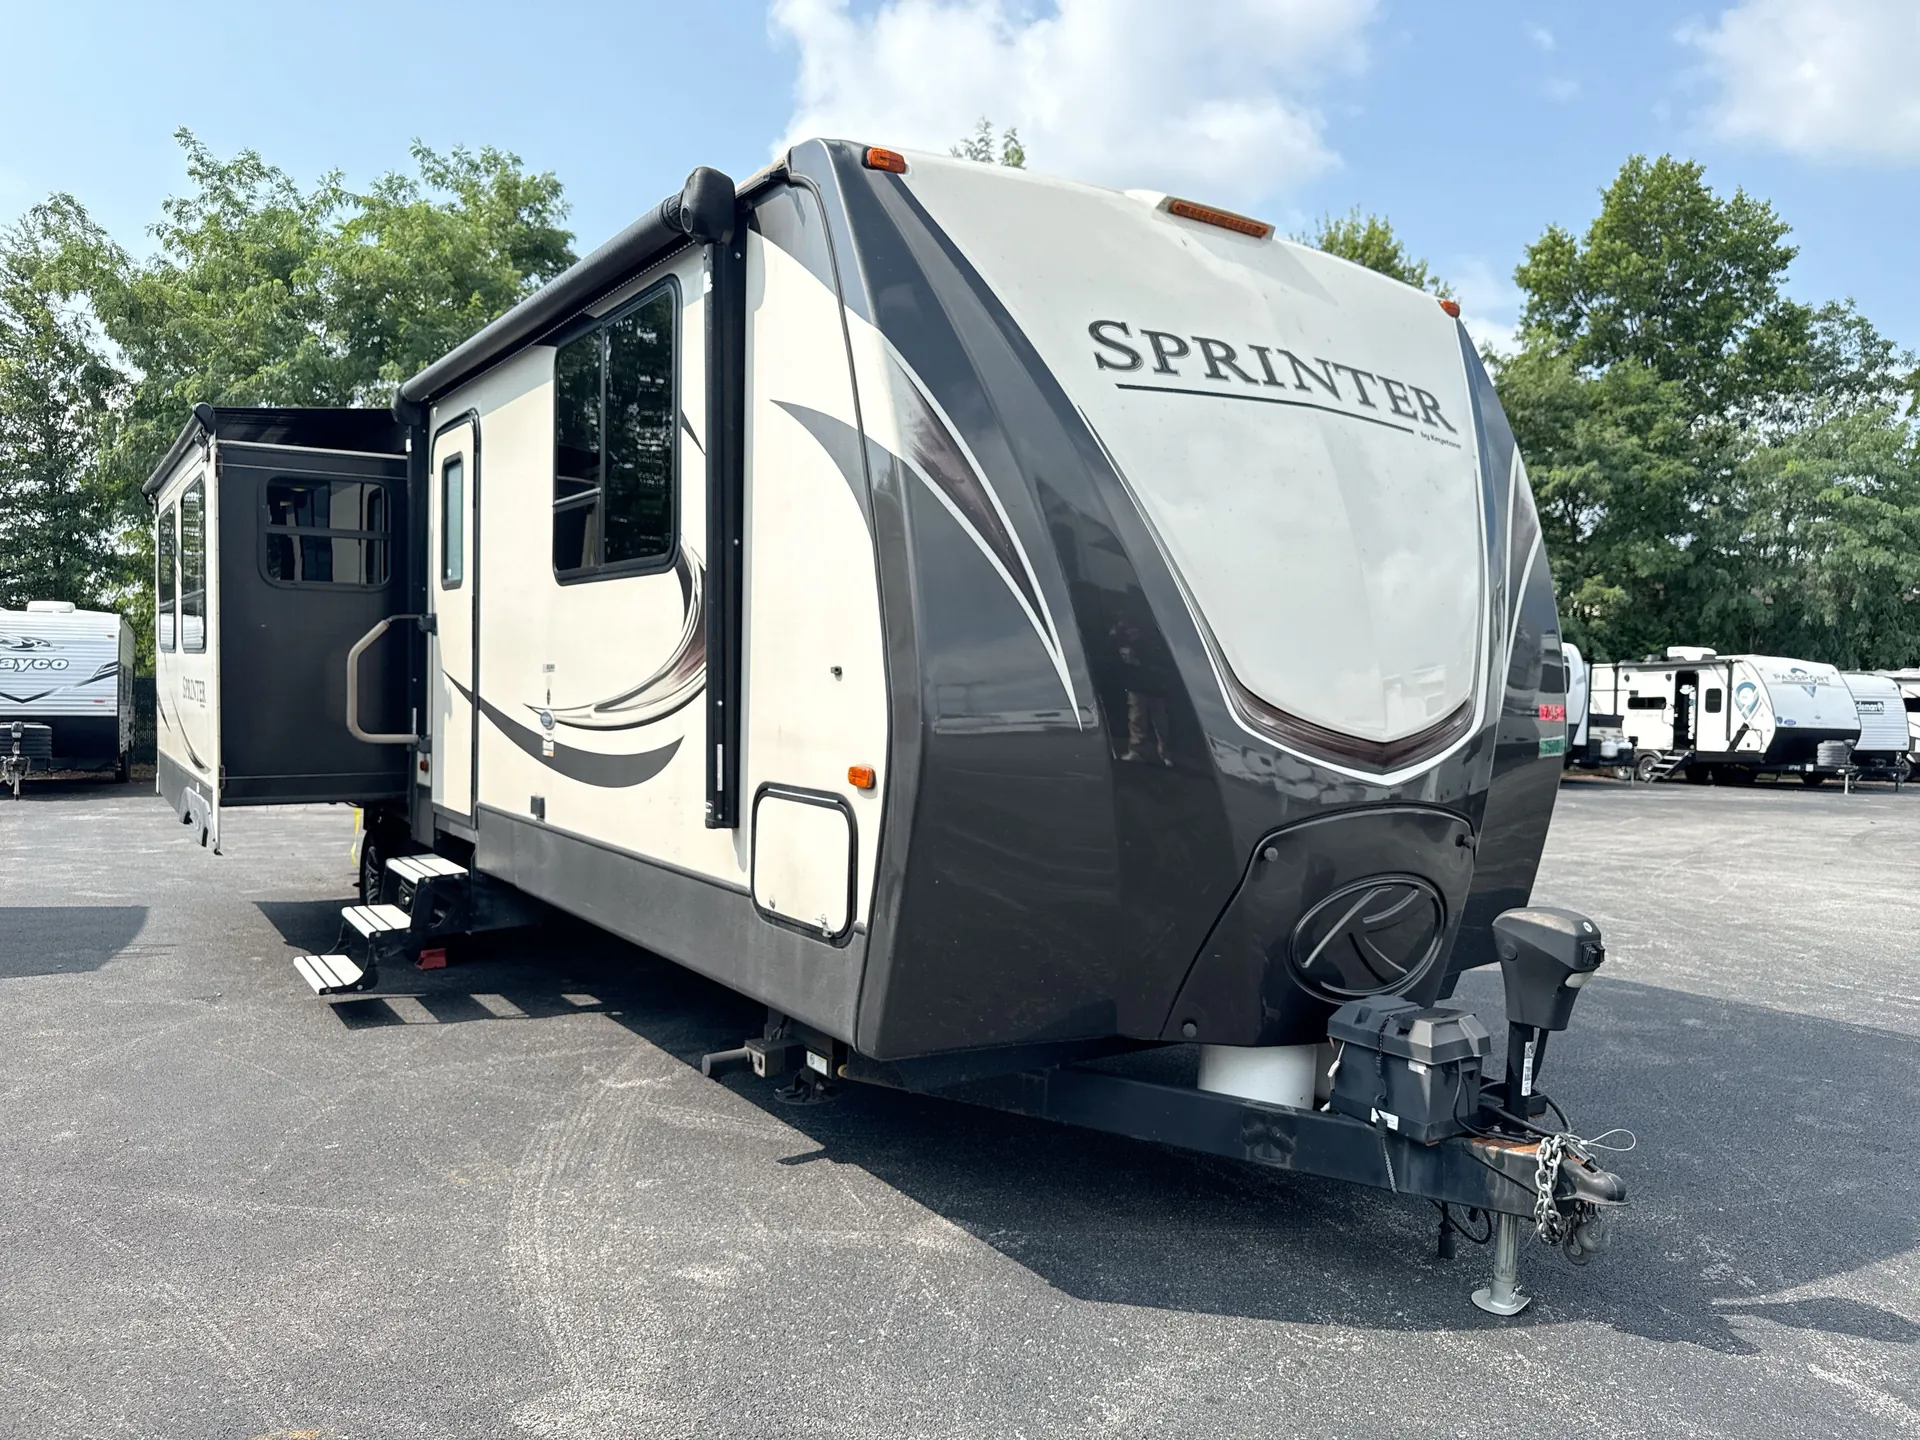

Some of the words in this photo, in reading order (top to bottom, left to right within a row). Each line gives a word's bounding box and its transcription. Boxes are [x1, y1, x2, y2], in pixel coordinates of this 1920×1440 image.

[1087, 318, 1458, 434] SPRINTER
[1420, 431, 1430, 441] by
[0, 656, 69, 672] ayco
[1773, 673, 1830, 683] PASSPORT
[182, 676, 206, 704] SPRINTER
